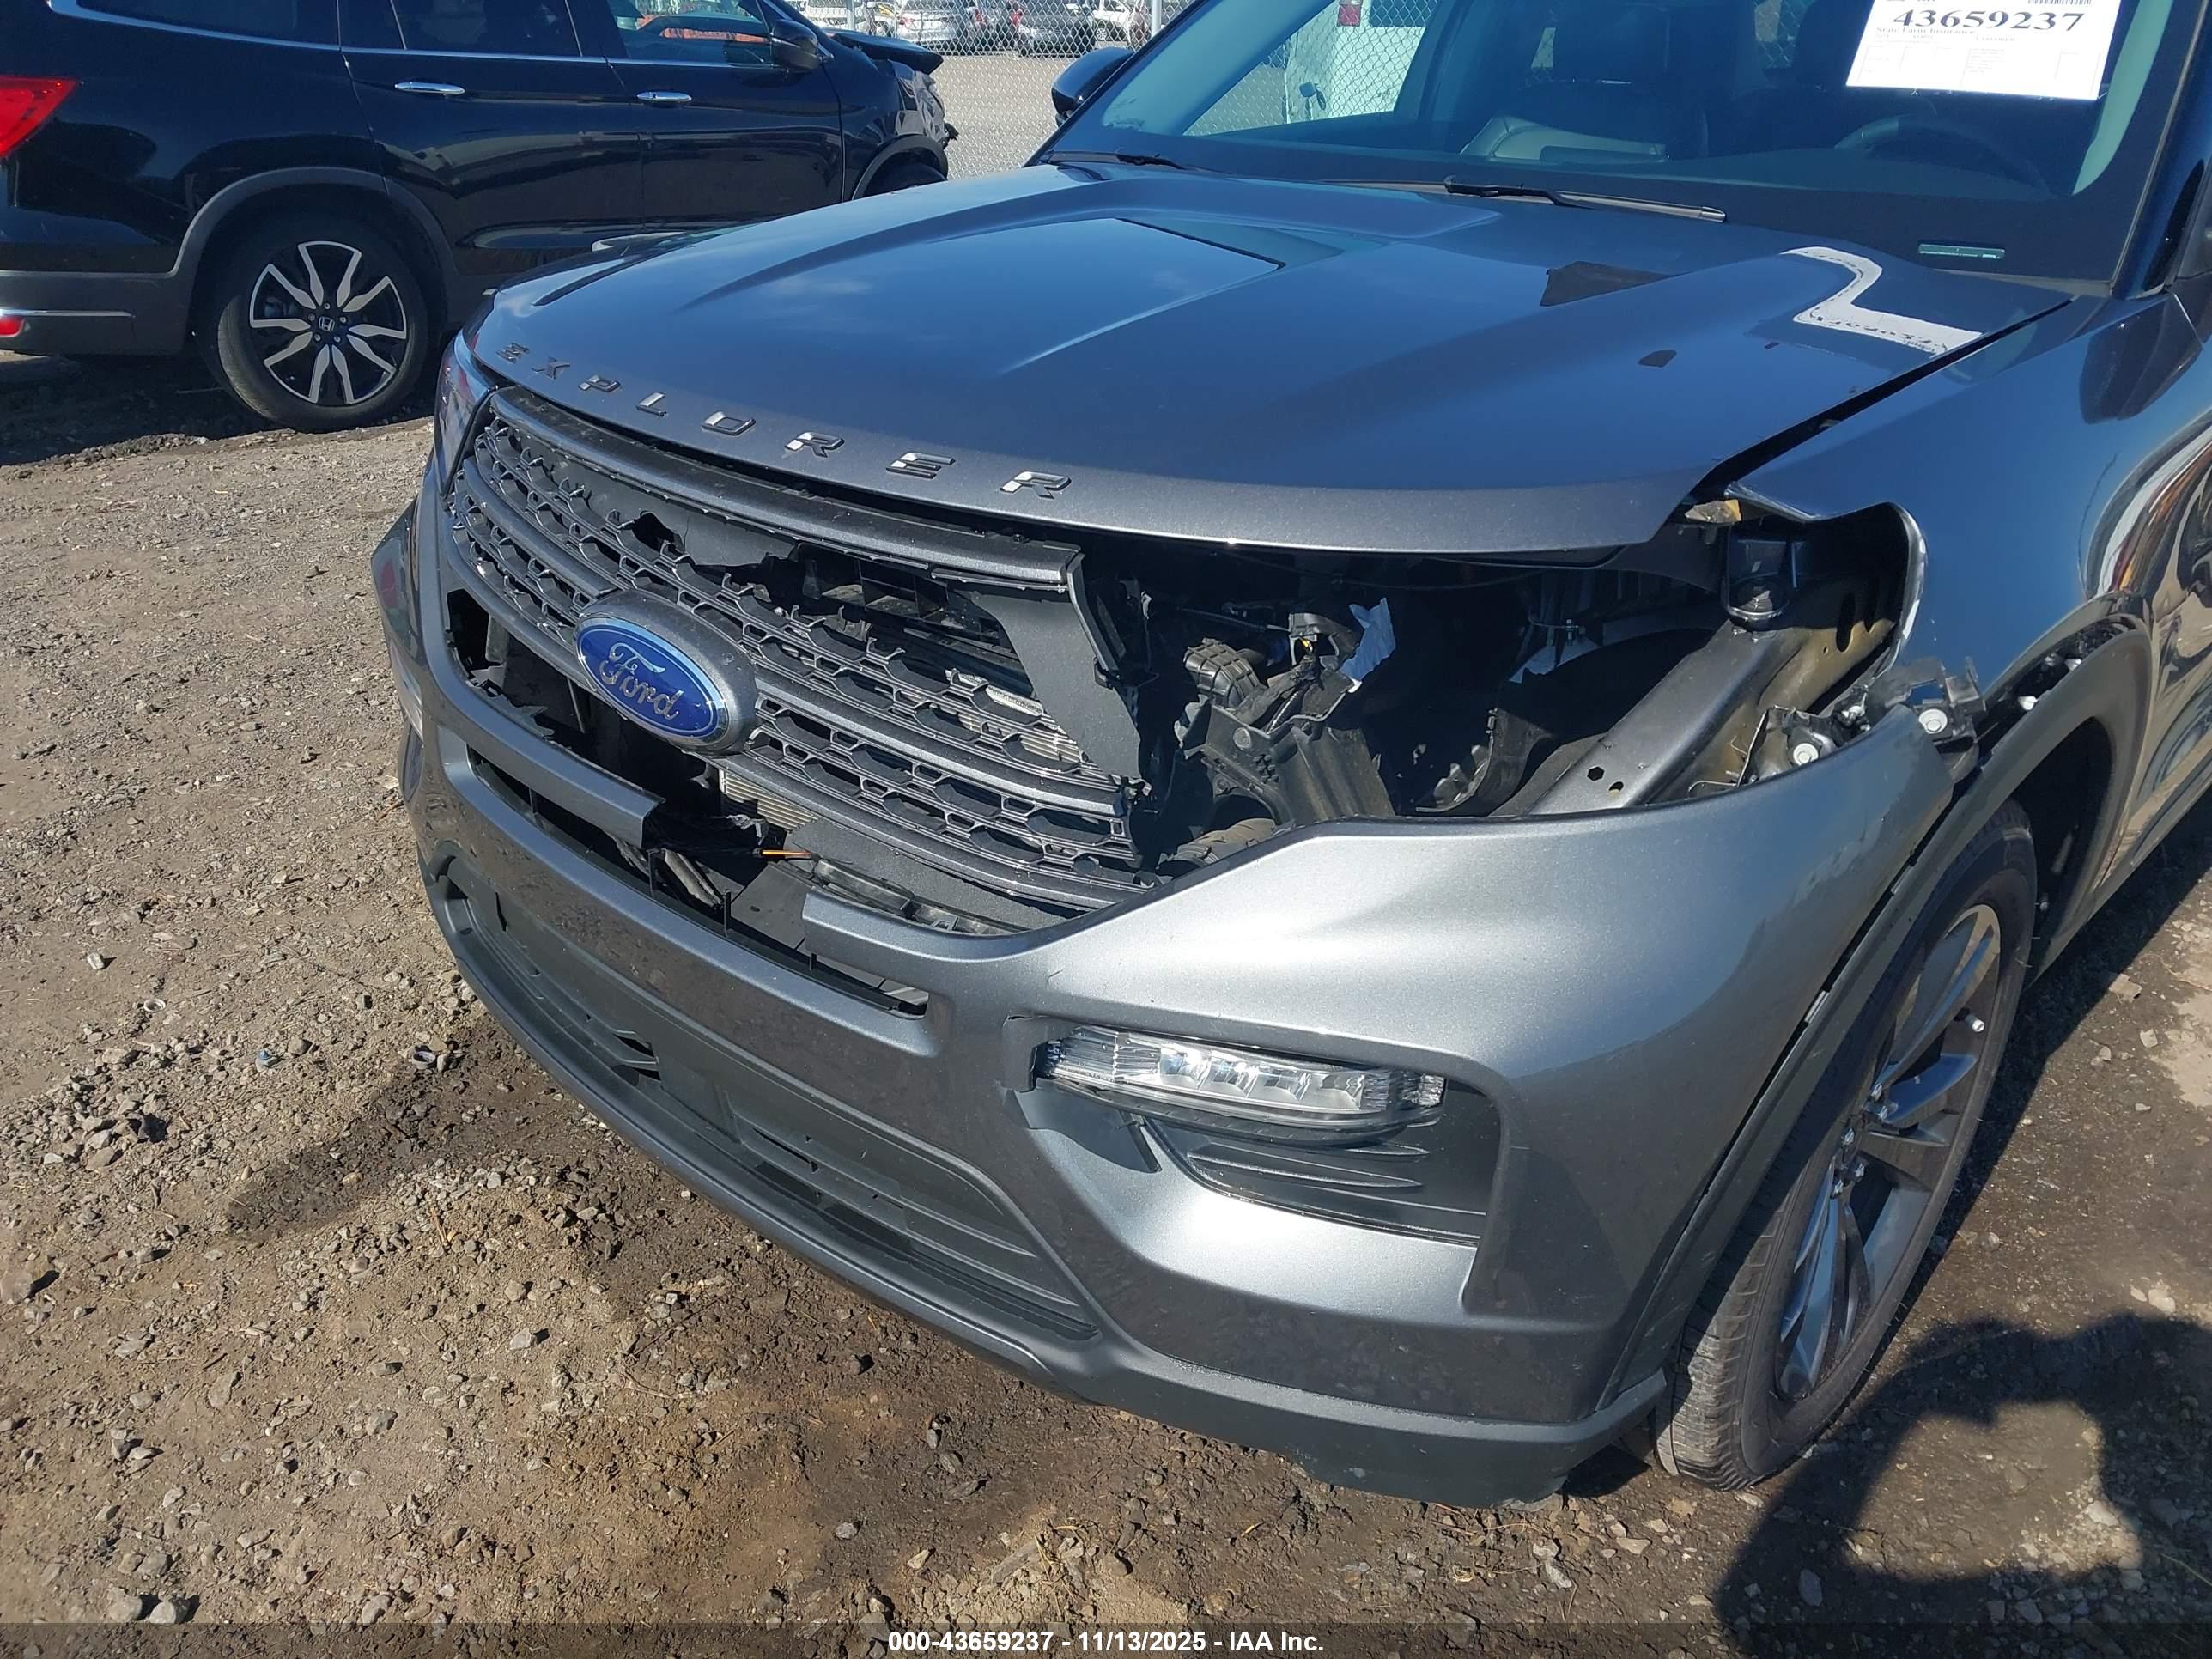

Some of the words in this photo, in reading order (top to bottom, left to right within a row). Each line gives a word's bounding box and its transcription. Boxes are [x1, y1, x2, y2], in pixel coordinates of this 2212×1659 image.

[1893, 9, 2085, 32] 43659237
[498, 342, 1072, 500] EXPLORER
[599, 642, 684, 720] Ford
